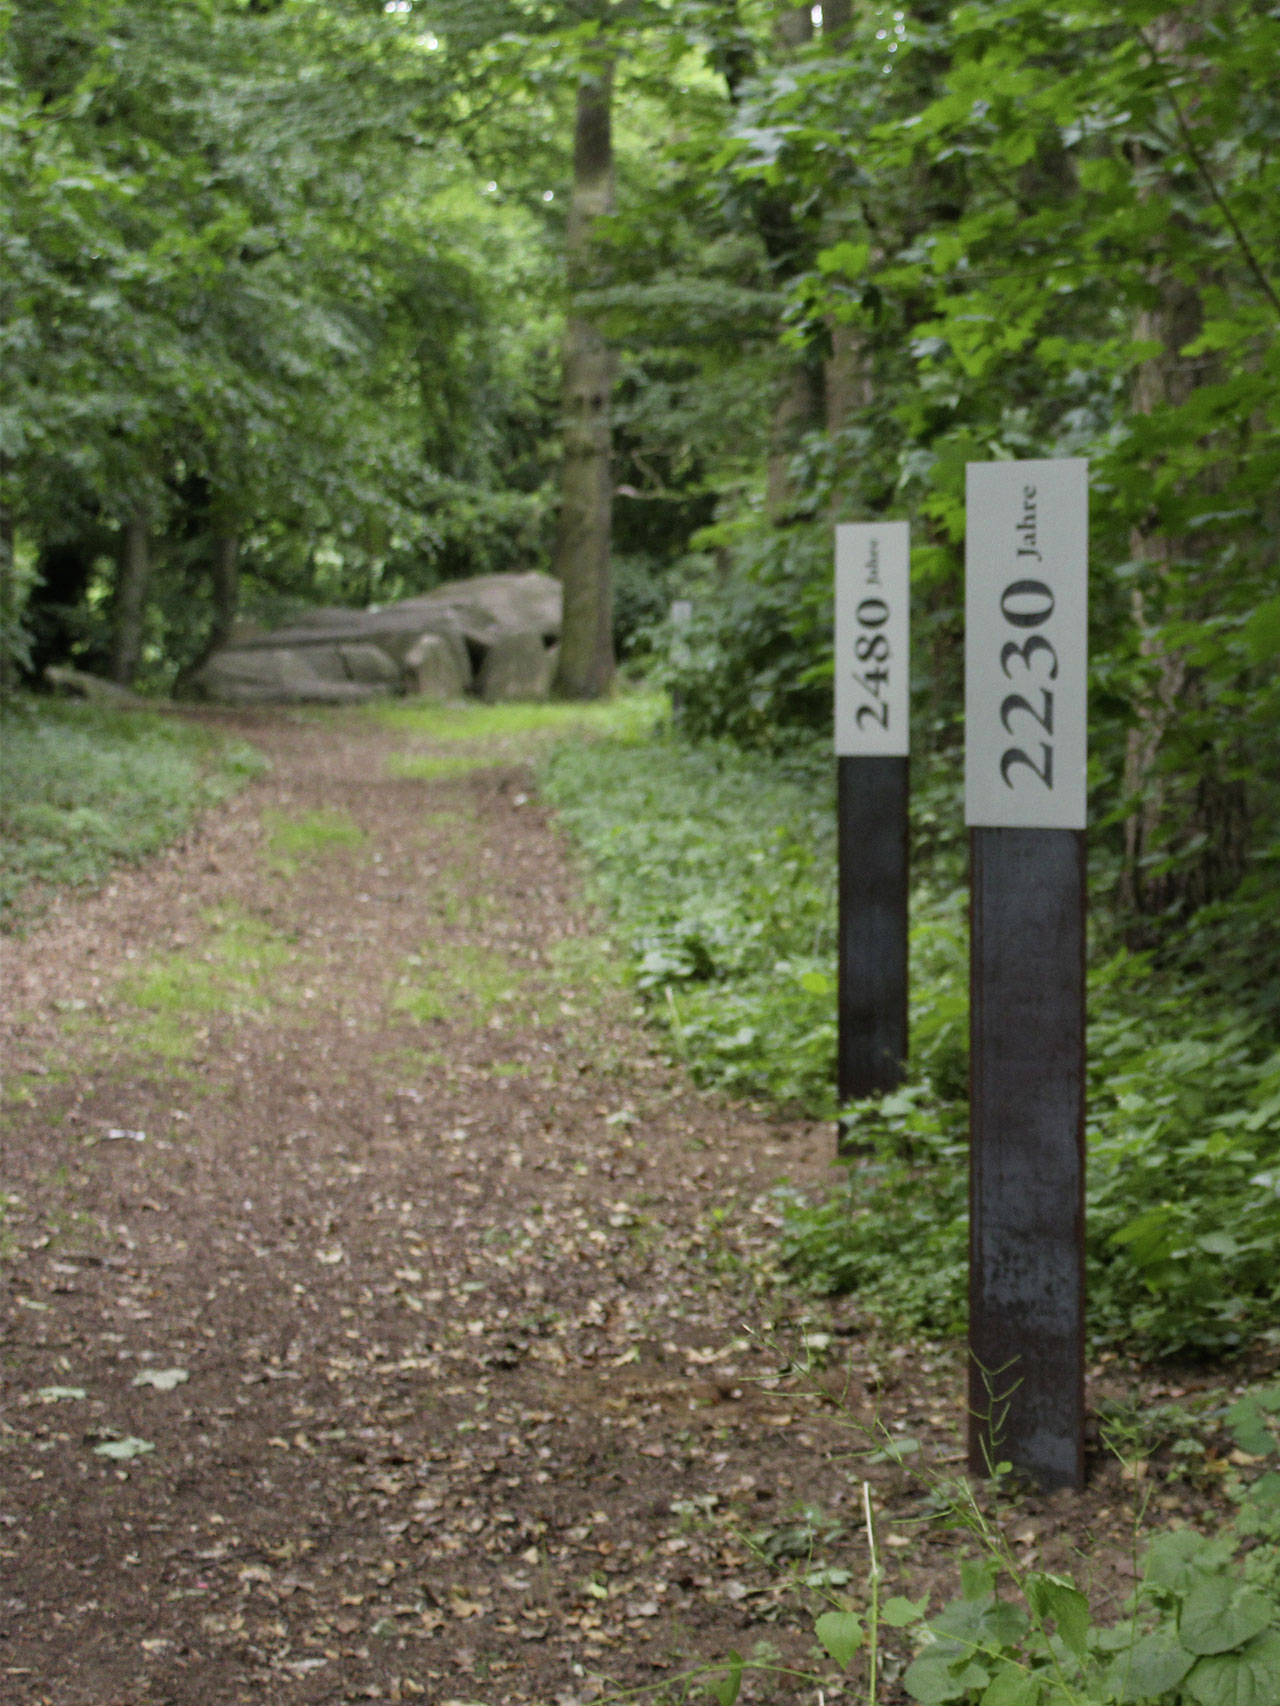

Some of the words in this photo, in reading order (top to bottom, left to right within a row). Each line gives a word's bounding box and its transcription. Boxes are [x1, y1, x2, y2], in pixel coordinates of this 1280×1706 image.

[1014, 484, 1043, 563] Jahre
[854, 597, 891, 732] 2480
[998, 578, 1060, 792] 2230
